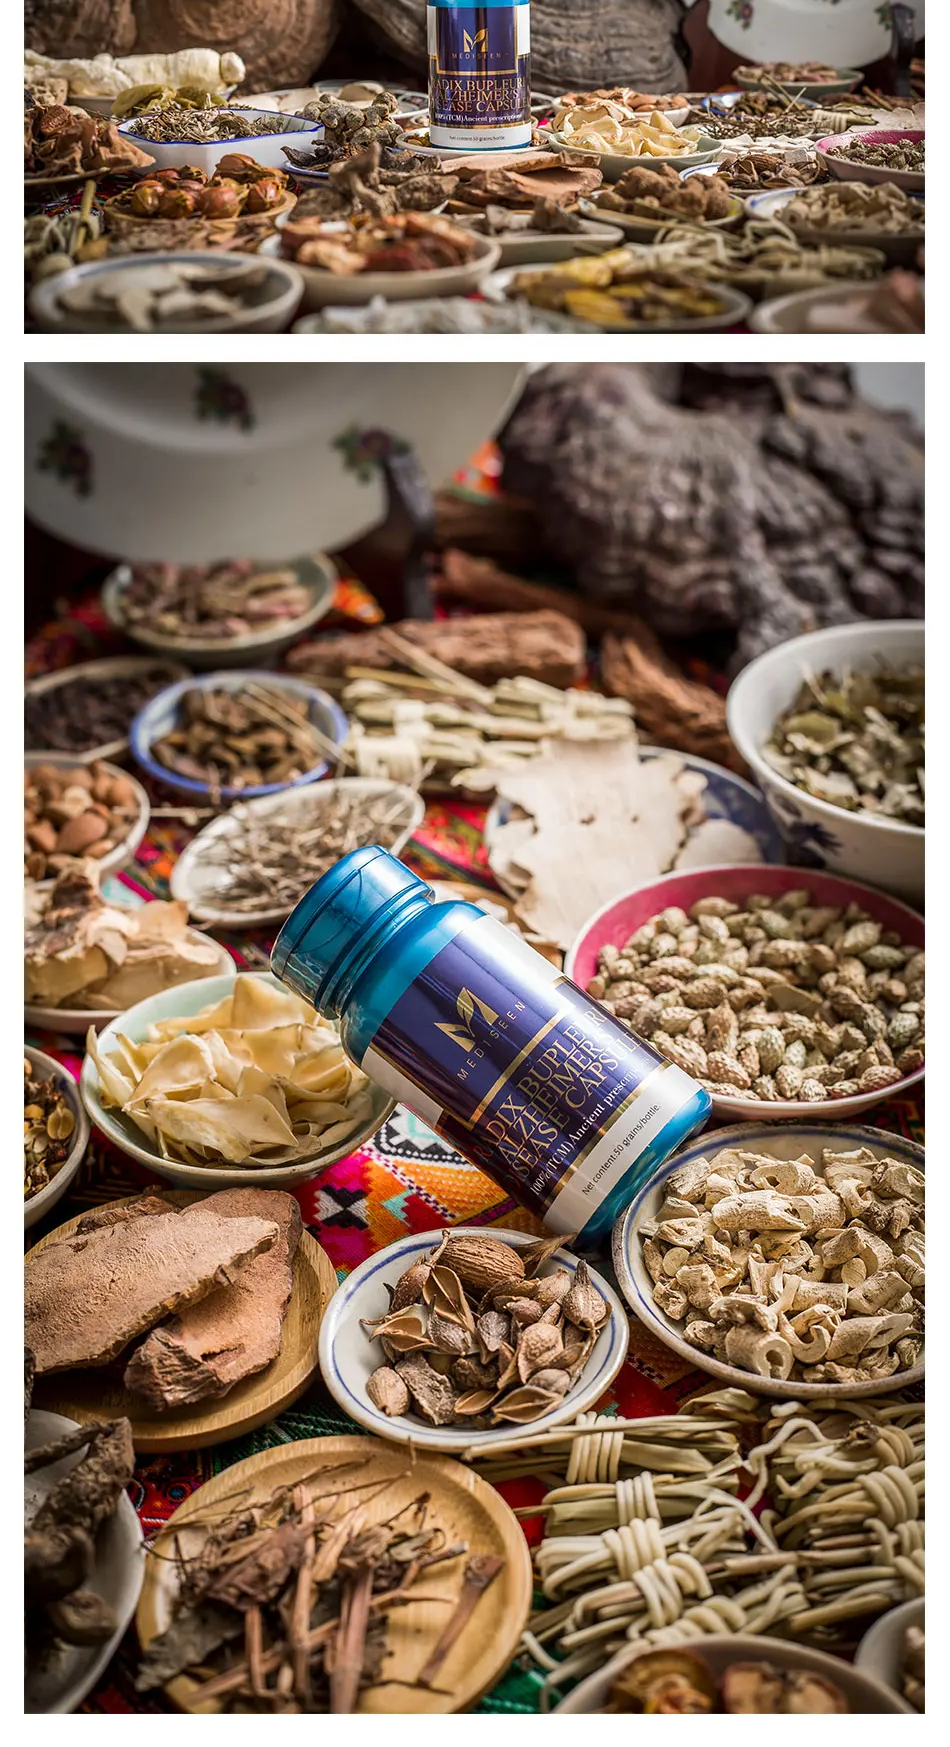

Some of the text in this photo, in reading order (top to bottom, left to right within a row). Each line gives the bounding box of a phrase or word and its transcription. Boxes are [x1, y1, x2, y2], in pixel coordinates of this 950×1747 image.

[456, 1001, 526, 1081] MEDISEEN
[565, 1031, 643, 1110] CAPSULE
[582, 1181, 596, 1197] Net
